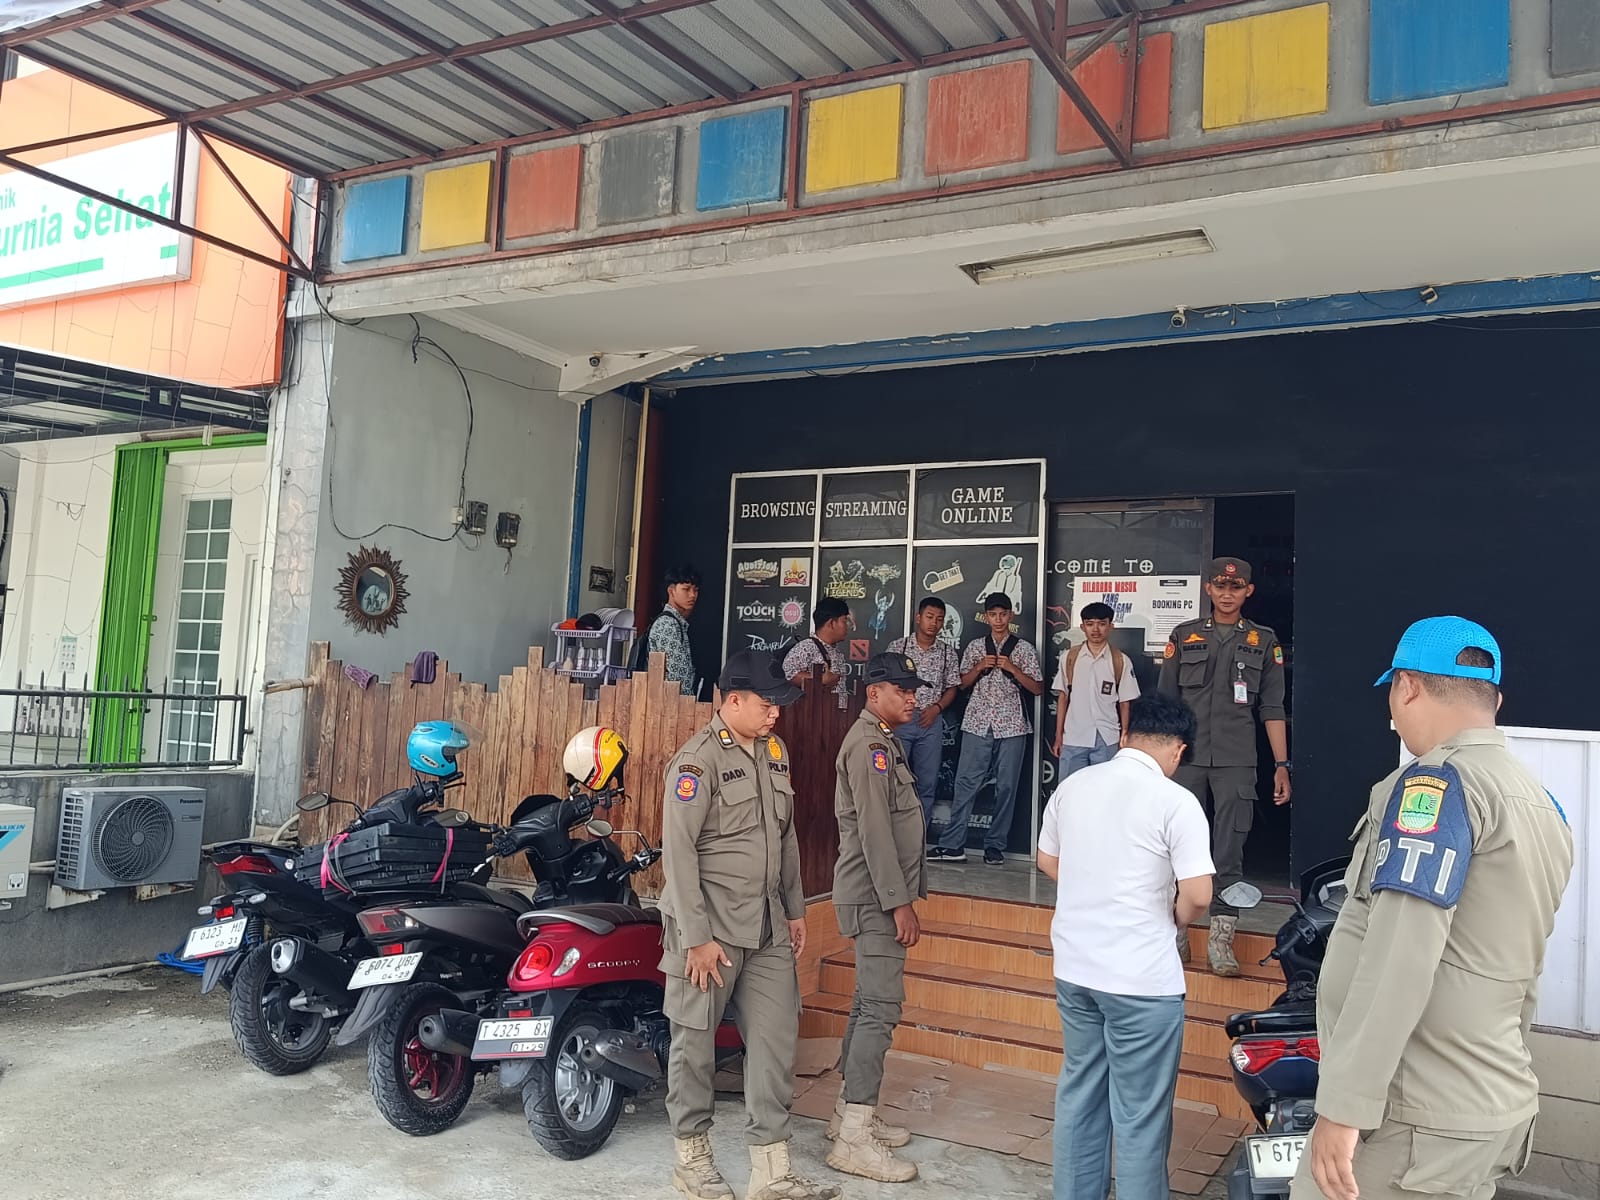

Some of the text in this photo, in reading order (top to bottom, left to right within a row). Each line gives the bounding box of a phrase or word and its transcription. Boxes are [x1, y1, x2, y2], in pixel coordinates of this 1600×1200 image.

[74, 182, 172, 241] Sehat
[951, 487, 1005, 504] GAME
[741, 501, 817, 518] BROWSING
[825, 501, 908, 518] STREAMING
[941, 506, 1013, 524] ONLINE
[1047, 559, 1154, 574] COME TO
[736, 605, 776, 619] TOUCH
[1152, 599, 1193, 609] BOOKING PC
[722, 767, 746, 782] DADI
[483, 1025, 489, 1038] T
[493, 1023, 521, 1038] 4325
[1252, 1143, 1262, 1164] T
